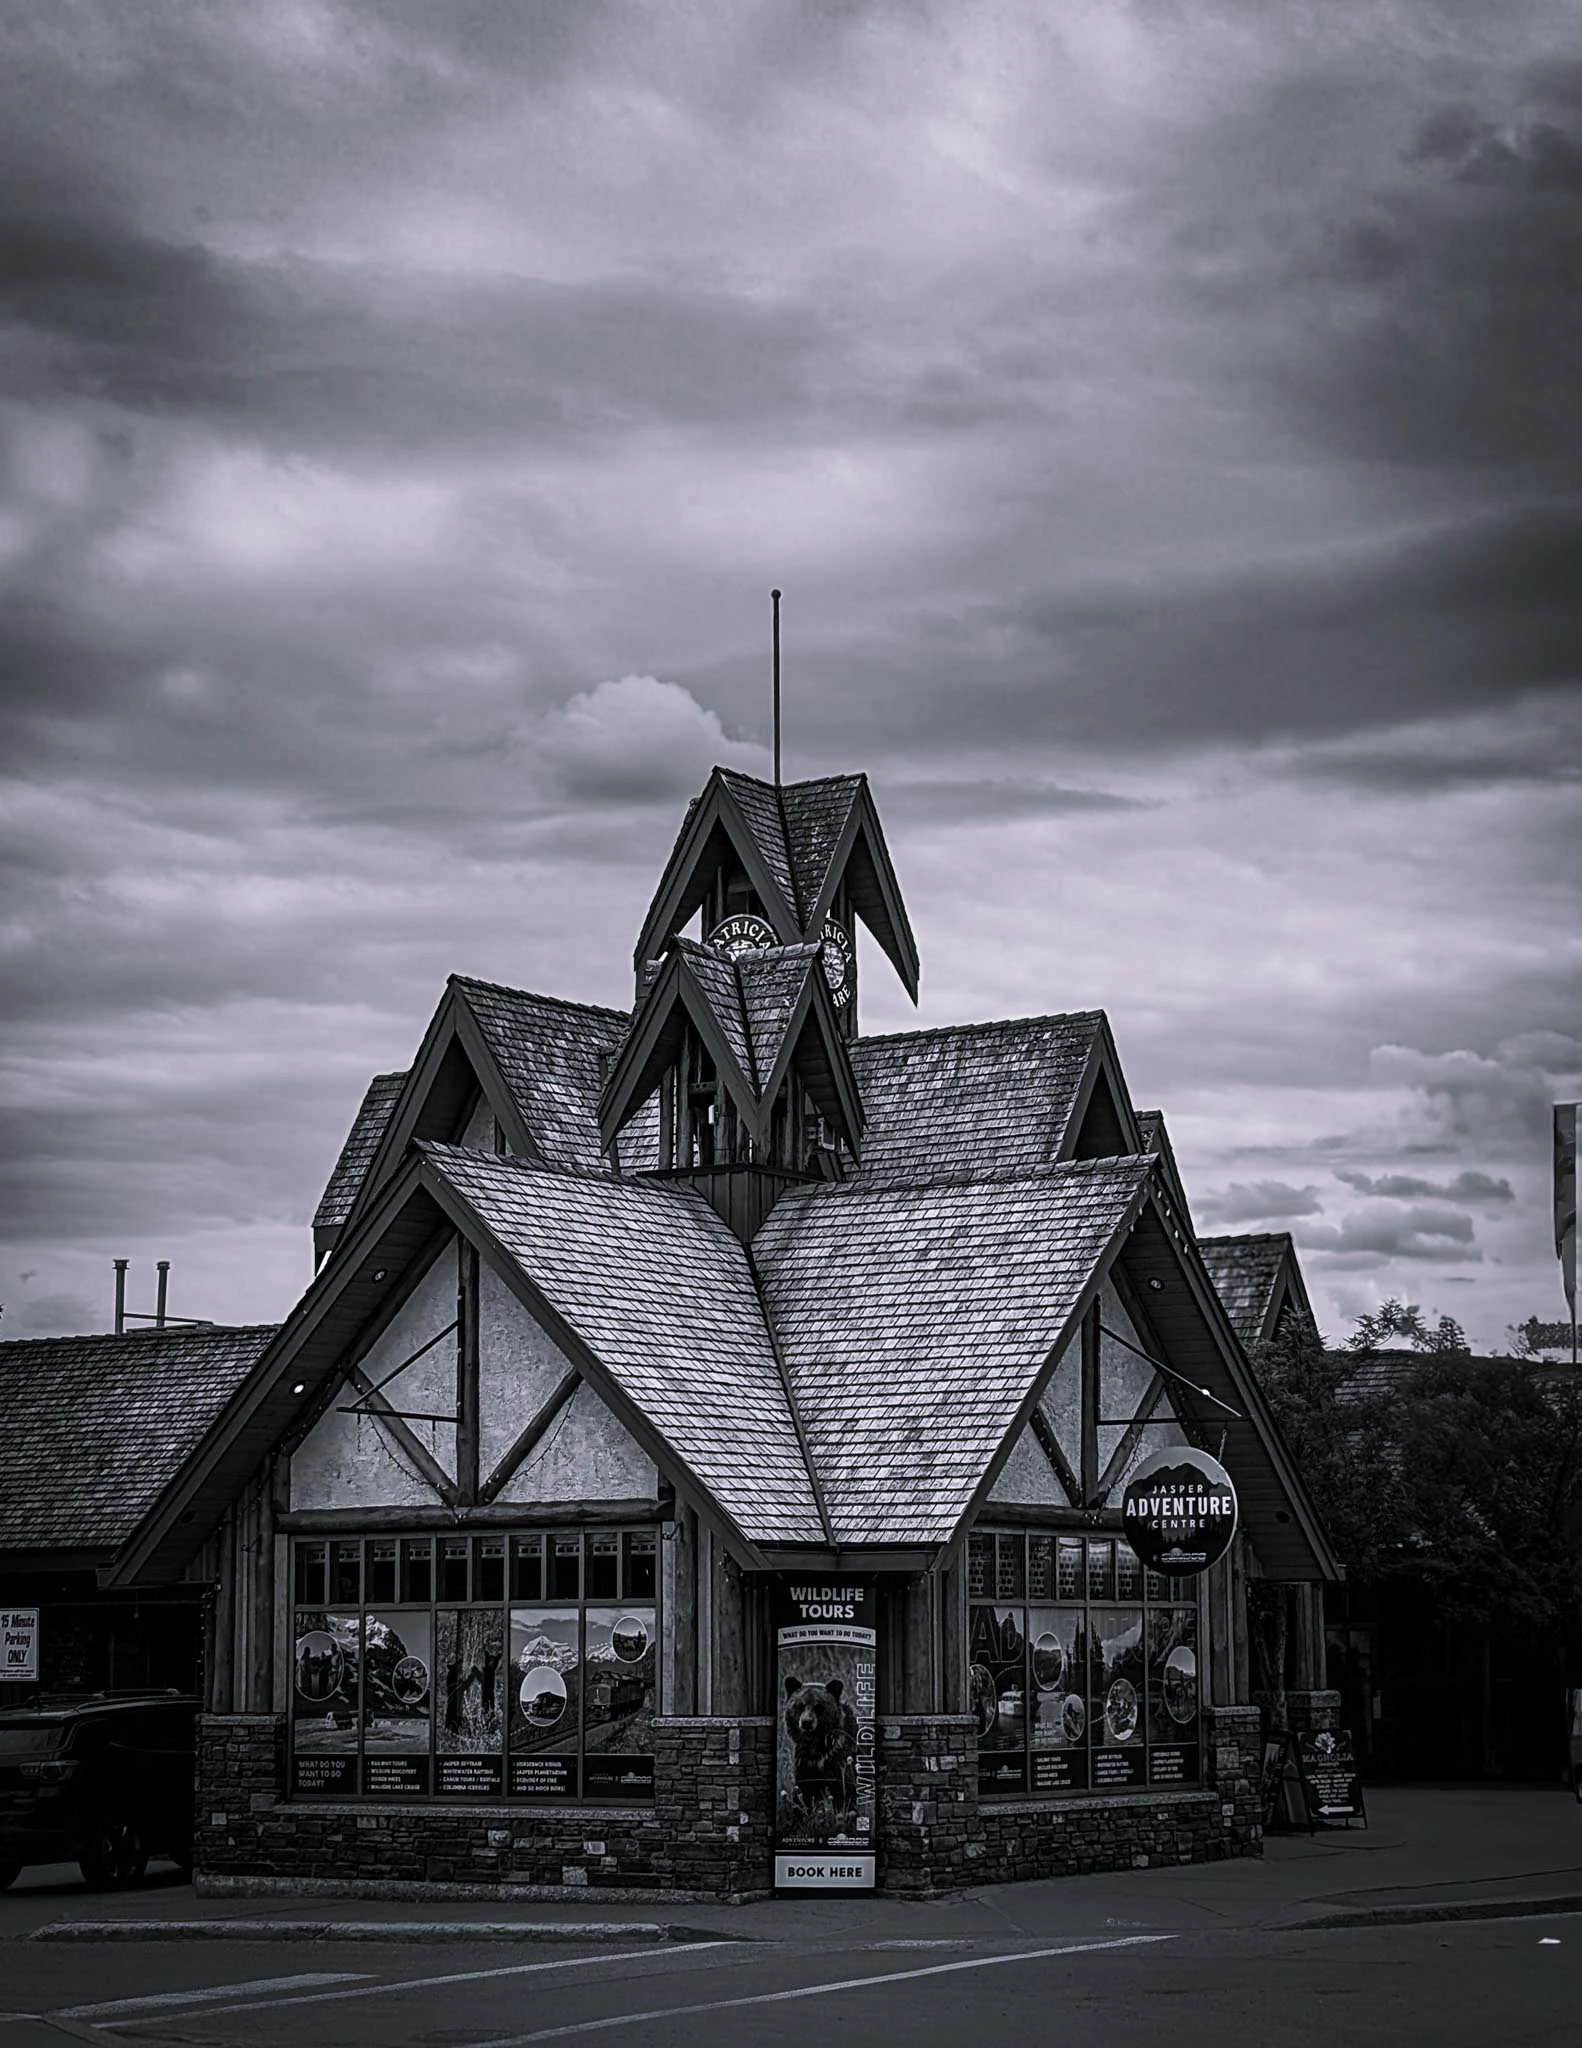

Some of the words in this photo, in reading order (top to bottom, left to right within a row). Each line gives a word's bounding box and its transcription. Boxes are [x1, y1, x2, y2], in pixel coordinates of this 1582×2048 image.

[713, 921, 771, 950] ATRICIA
[1152, 1484, 1204, 1494] JASPER
[1126, 1496, 1232, 1517] ADVENTURE
[1152, 1519, 1206, 1529] CENTRE
[790, 1587, 864, 1602] WILDLIFE
[799, 1604, 855, 1619] TOURS
[1, 1614, 9, 1628] 15
[11, 1614, 35, 1628] Minute
[5, 1632, 31, 1648] Parking
[783, 1631, 798, 1639] WHAT
[852, 1631, 872, 1640] TODAY?
[8, 1649, 27, 1663] ONLY
[856, 1663, 876, 1806] WILDLIFE
[299, 1760, 318, 1768] WHAT
[319, 1760, 330, 1768] DO
[331, 1760, 346, 1768] YOU
[298, 1769, 319, 1777] WANT
[320, 1769, 330, 1777] TO
[331, 1769, 341, 1778] DO
[298, 1779, 325, 1788] TODAY?
[788, 1866, 825, 1877] BOOK
[830, 1866, 862, 1877] HERE
